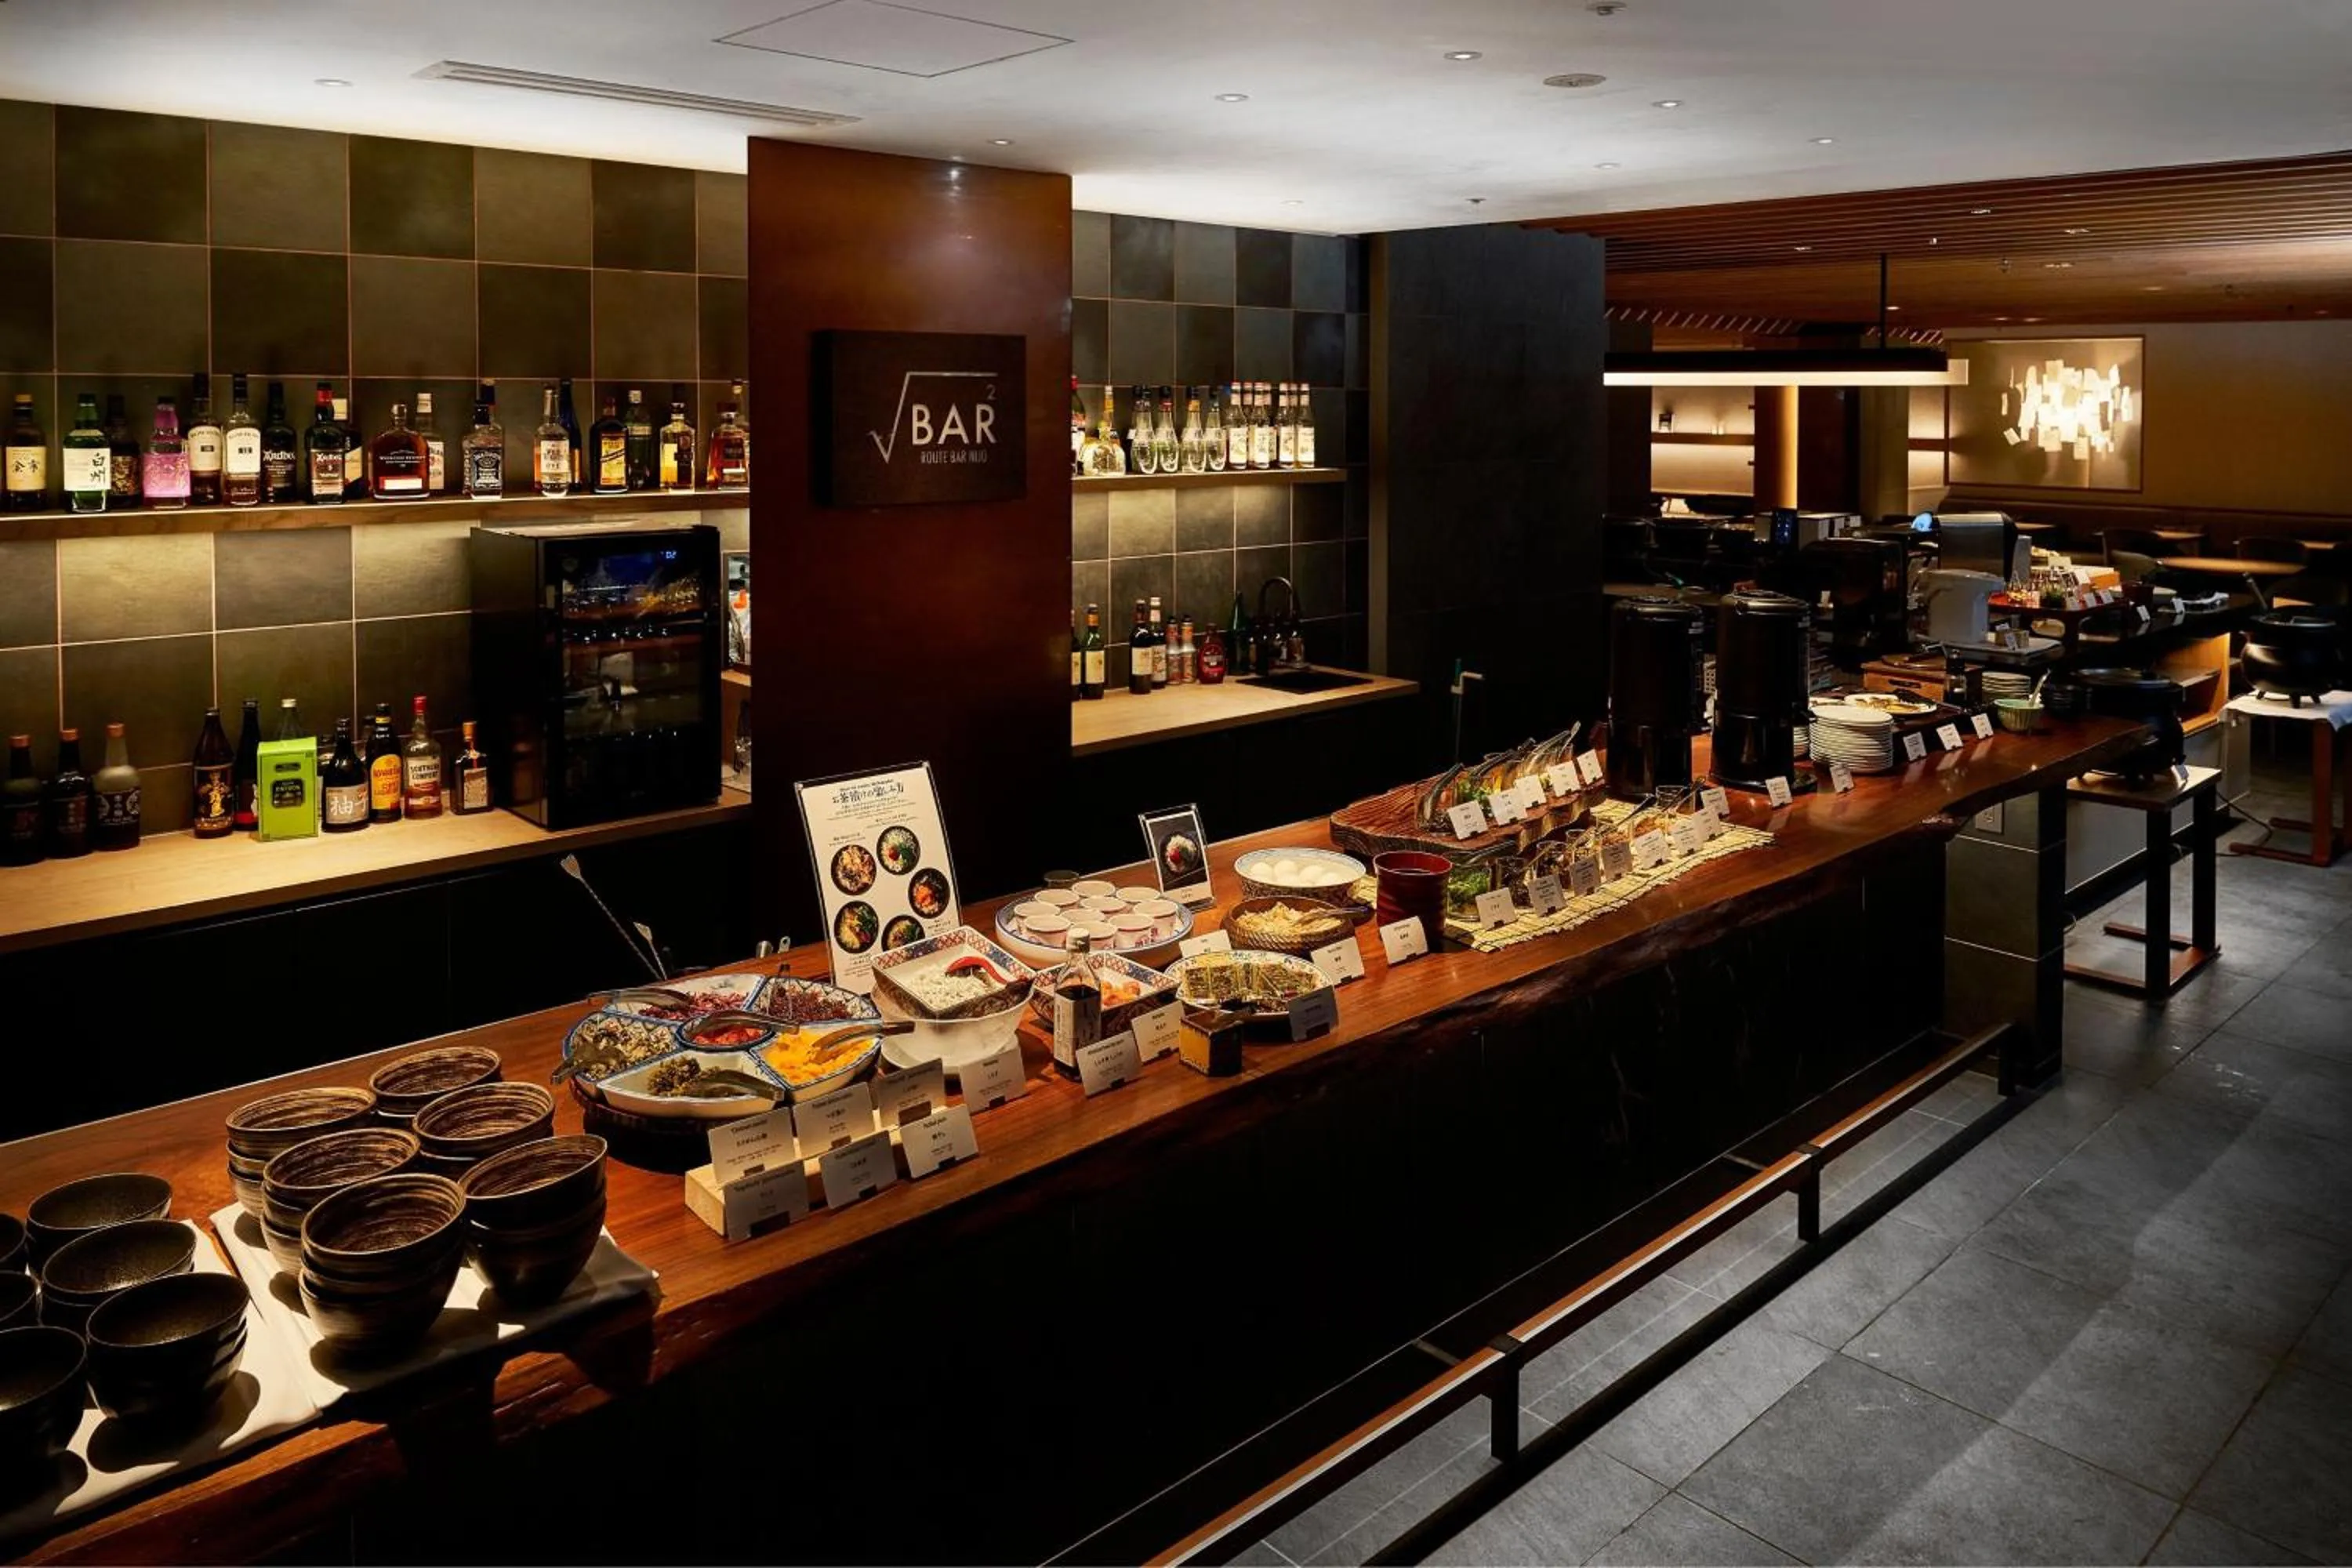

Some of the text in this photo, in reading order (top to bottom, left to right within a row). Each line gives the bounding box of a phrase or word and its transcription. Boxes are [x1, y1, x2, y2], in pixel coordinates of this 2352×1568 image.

[985, 384, 997, 401] 2
[911, 403, 997, 446] BAR
[920, 451, 949, 464] ROUTE
[950, 450, 967, 463] BAR
